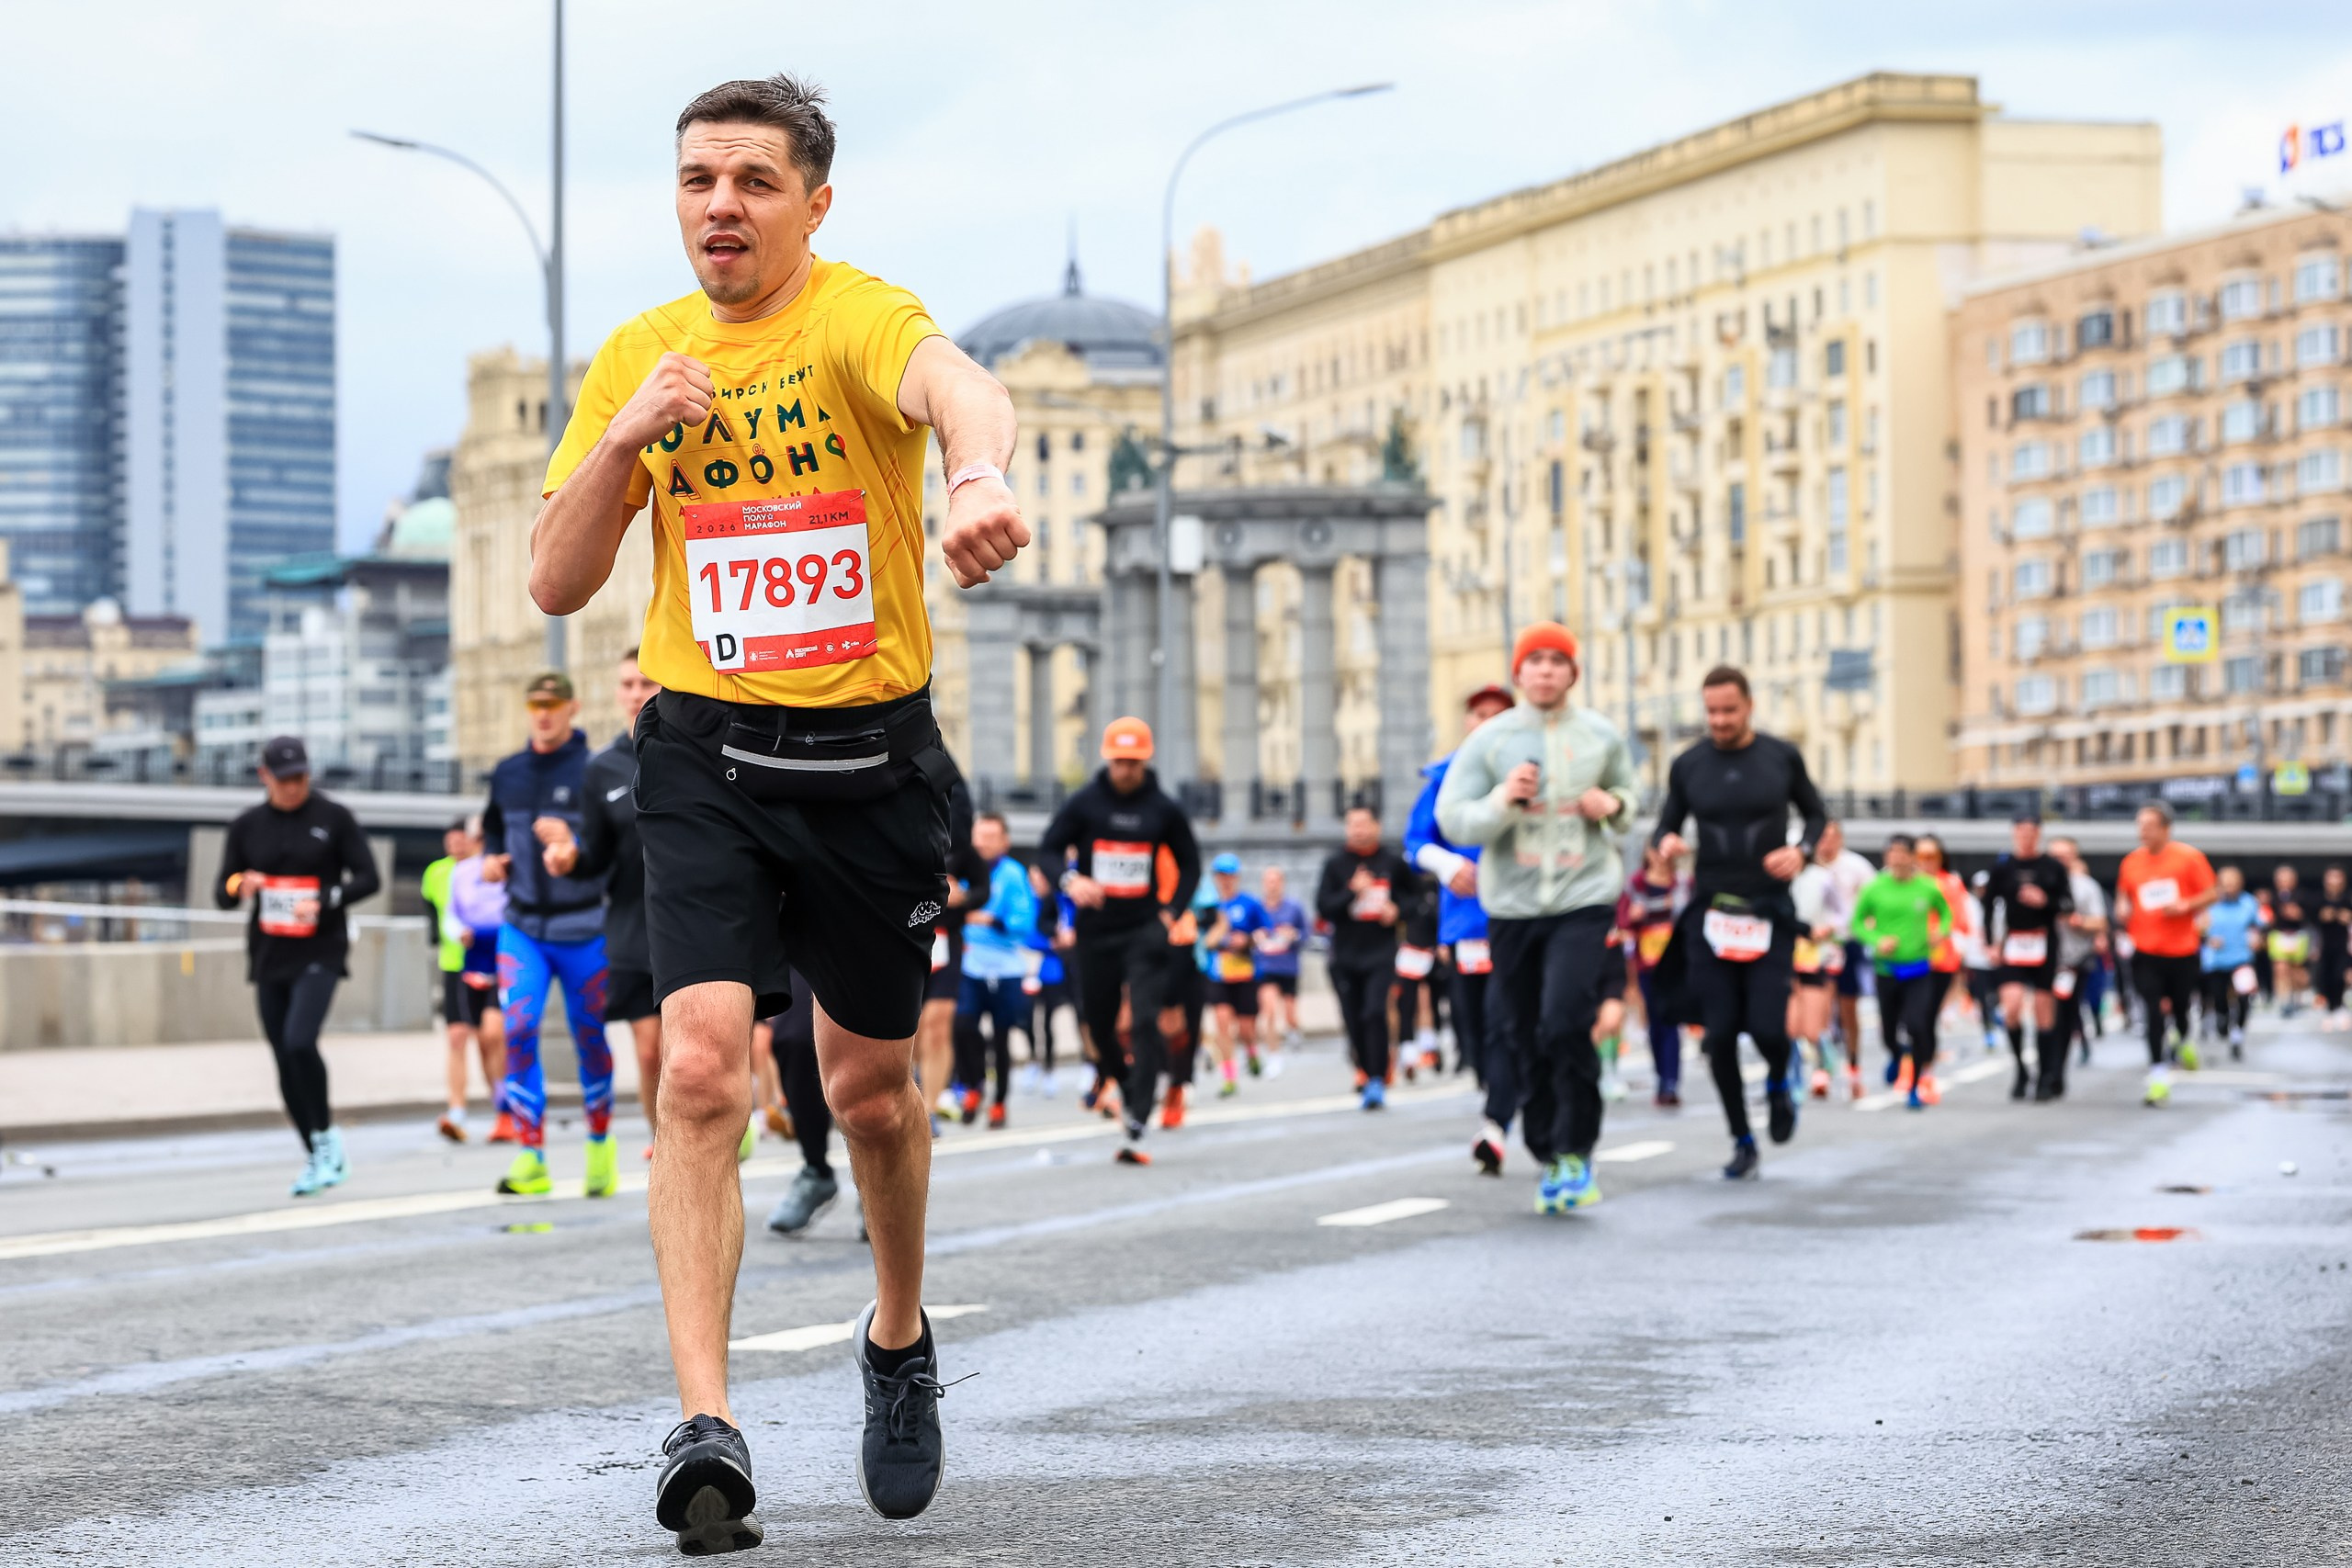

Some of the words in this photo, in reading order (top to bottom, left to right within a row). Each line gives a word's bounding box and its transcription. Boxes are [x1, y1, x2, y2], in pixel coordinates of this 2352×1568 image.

[741, 500, 802, 514] МОСКОВСКИЙ
[743, 513, 767, 523] ПОЛУ
[696, 524, 736, 534] 2026
[744, 520, 786, 530] МАРАФОН
[700, 548, 864, 613] 17893
[716, 633, 737, 661] D
